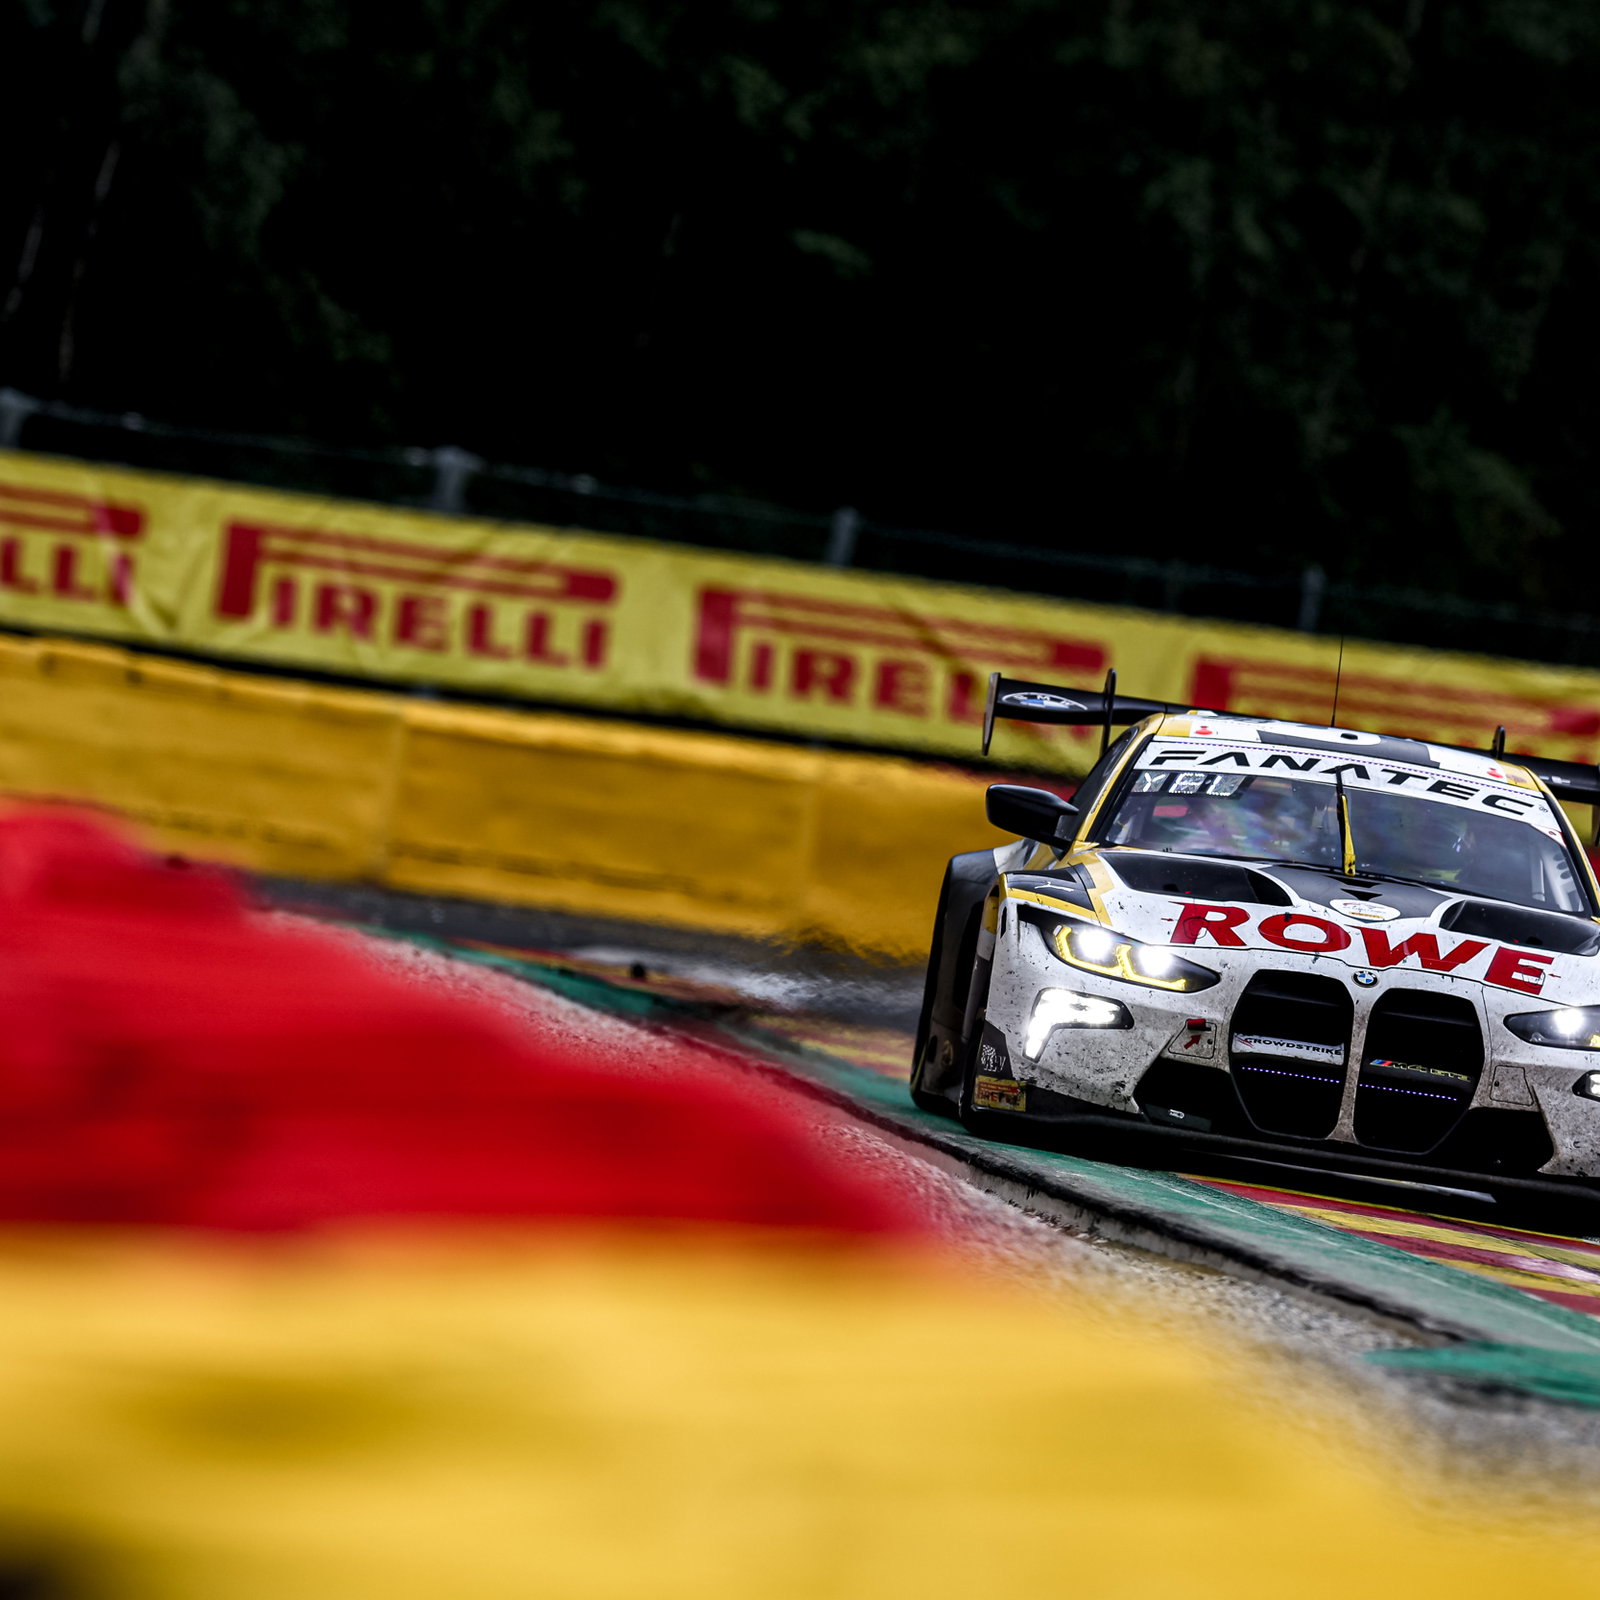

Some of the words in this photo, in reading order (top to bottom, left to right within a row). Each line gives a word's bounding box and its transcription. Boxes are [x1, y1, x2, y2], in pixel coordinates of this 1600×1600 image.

[215, 516, 621, 670] PIRELLI
[694, 583, 1112, 738] PIREL
[1150, 750, 1534, 816] FANATEC
[1168, 901, 1554, 995] ROWE
[1243, 1037, 1342, 1056] CROWDSTRIKE
